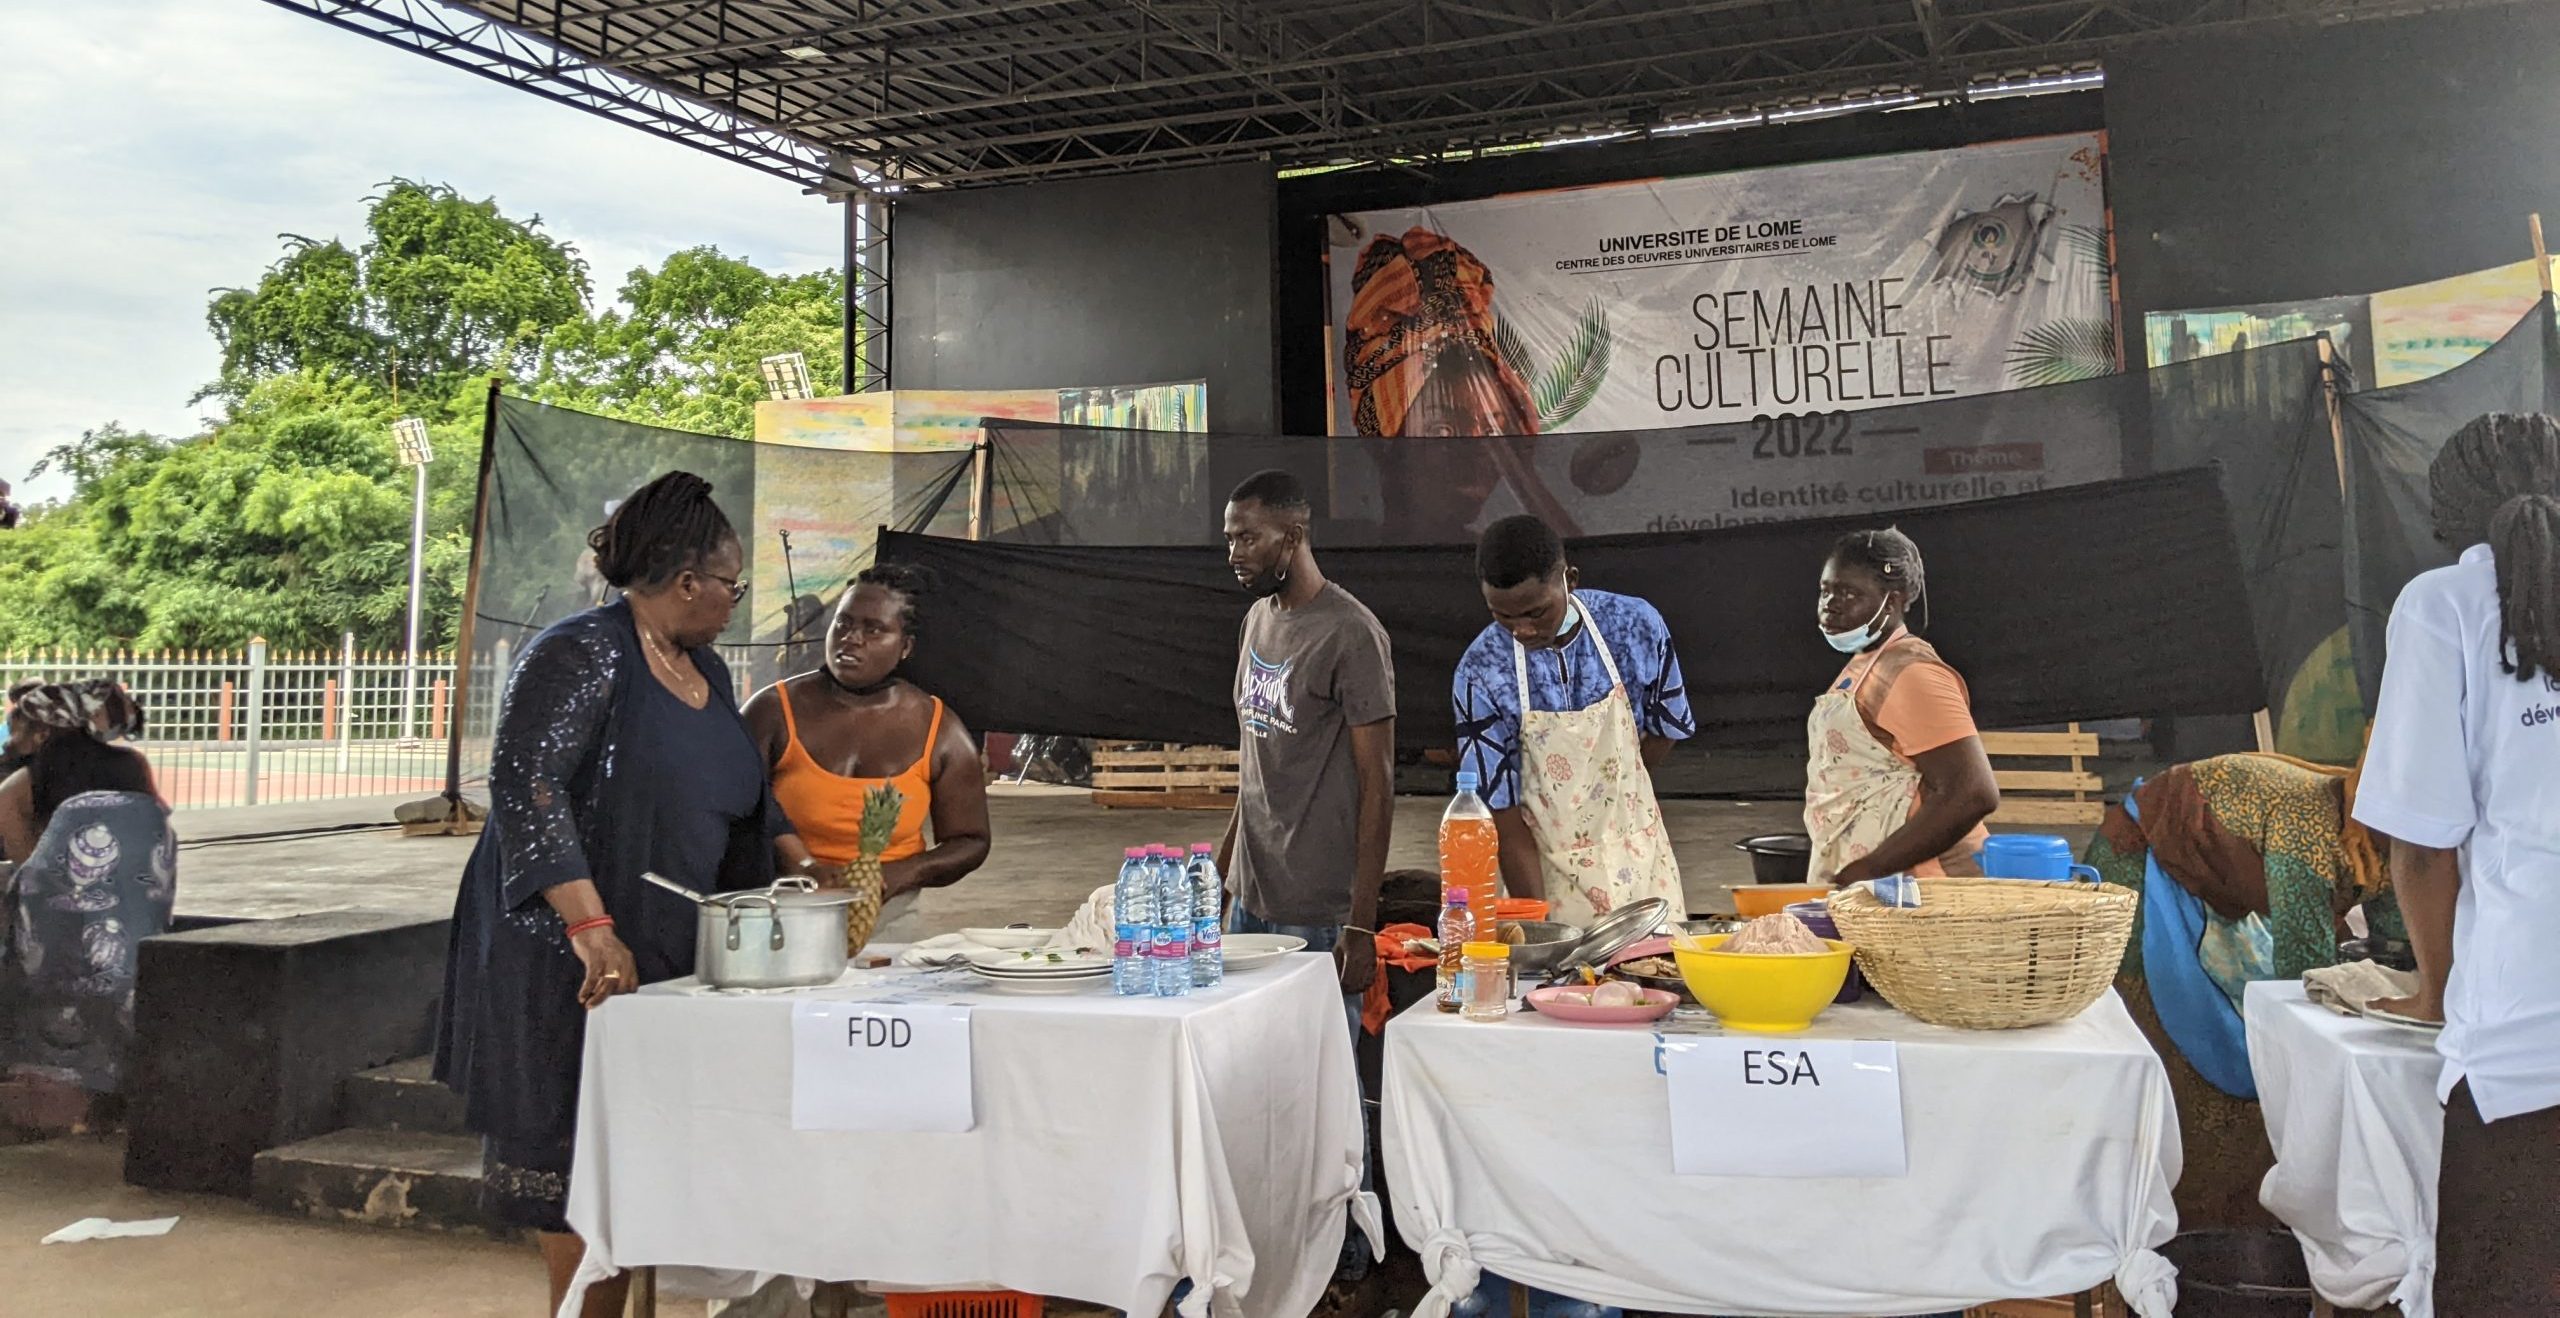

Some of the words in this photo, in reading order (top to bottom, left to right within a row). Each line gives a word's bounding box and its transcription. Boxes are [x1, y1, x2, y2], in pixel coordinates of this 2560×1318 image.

[1555, 257, 1600, 271] CENTRE
[1602, 255, 1626, 267] DES
[1627, 250, 1683, 264] OEUVRES
[1685, 240, 1780, 259] UNIVERSITAIRES
[1783, 238, 1800, 250] DE
[1802, 235, 1838, 248] LOME
[1599, 228, 1710, 253] UNIVERSITE
[1715, 225, 1741, 243] DE
[1747, 219, 1803, 239] LOME
[1692, 277, 1908, 351] SEMAINE
[1655, 335, 1957, 412] CULTURELLE
[1752, 409, 1853, 460] 2022
[1730, 482, 1849, 509] Identité
[1858, 475, 2007, 503] culturelle
[848, 1016, 912, 1048] FDD
[1743, 1049, 1820, 1087] ESA
